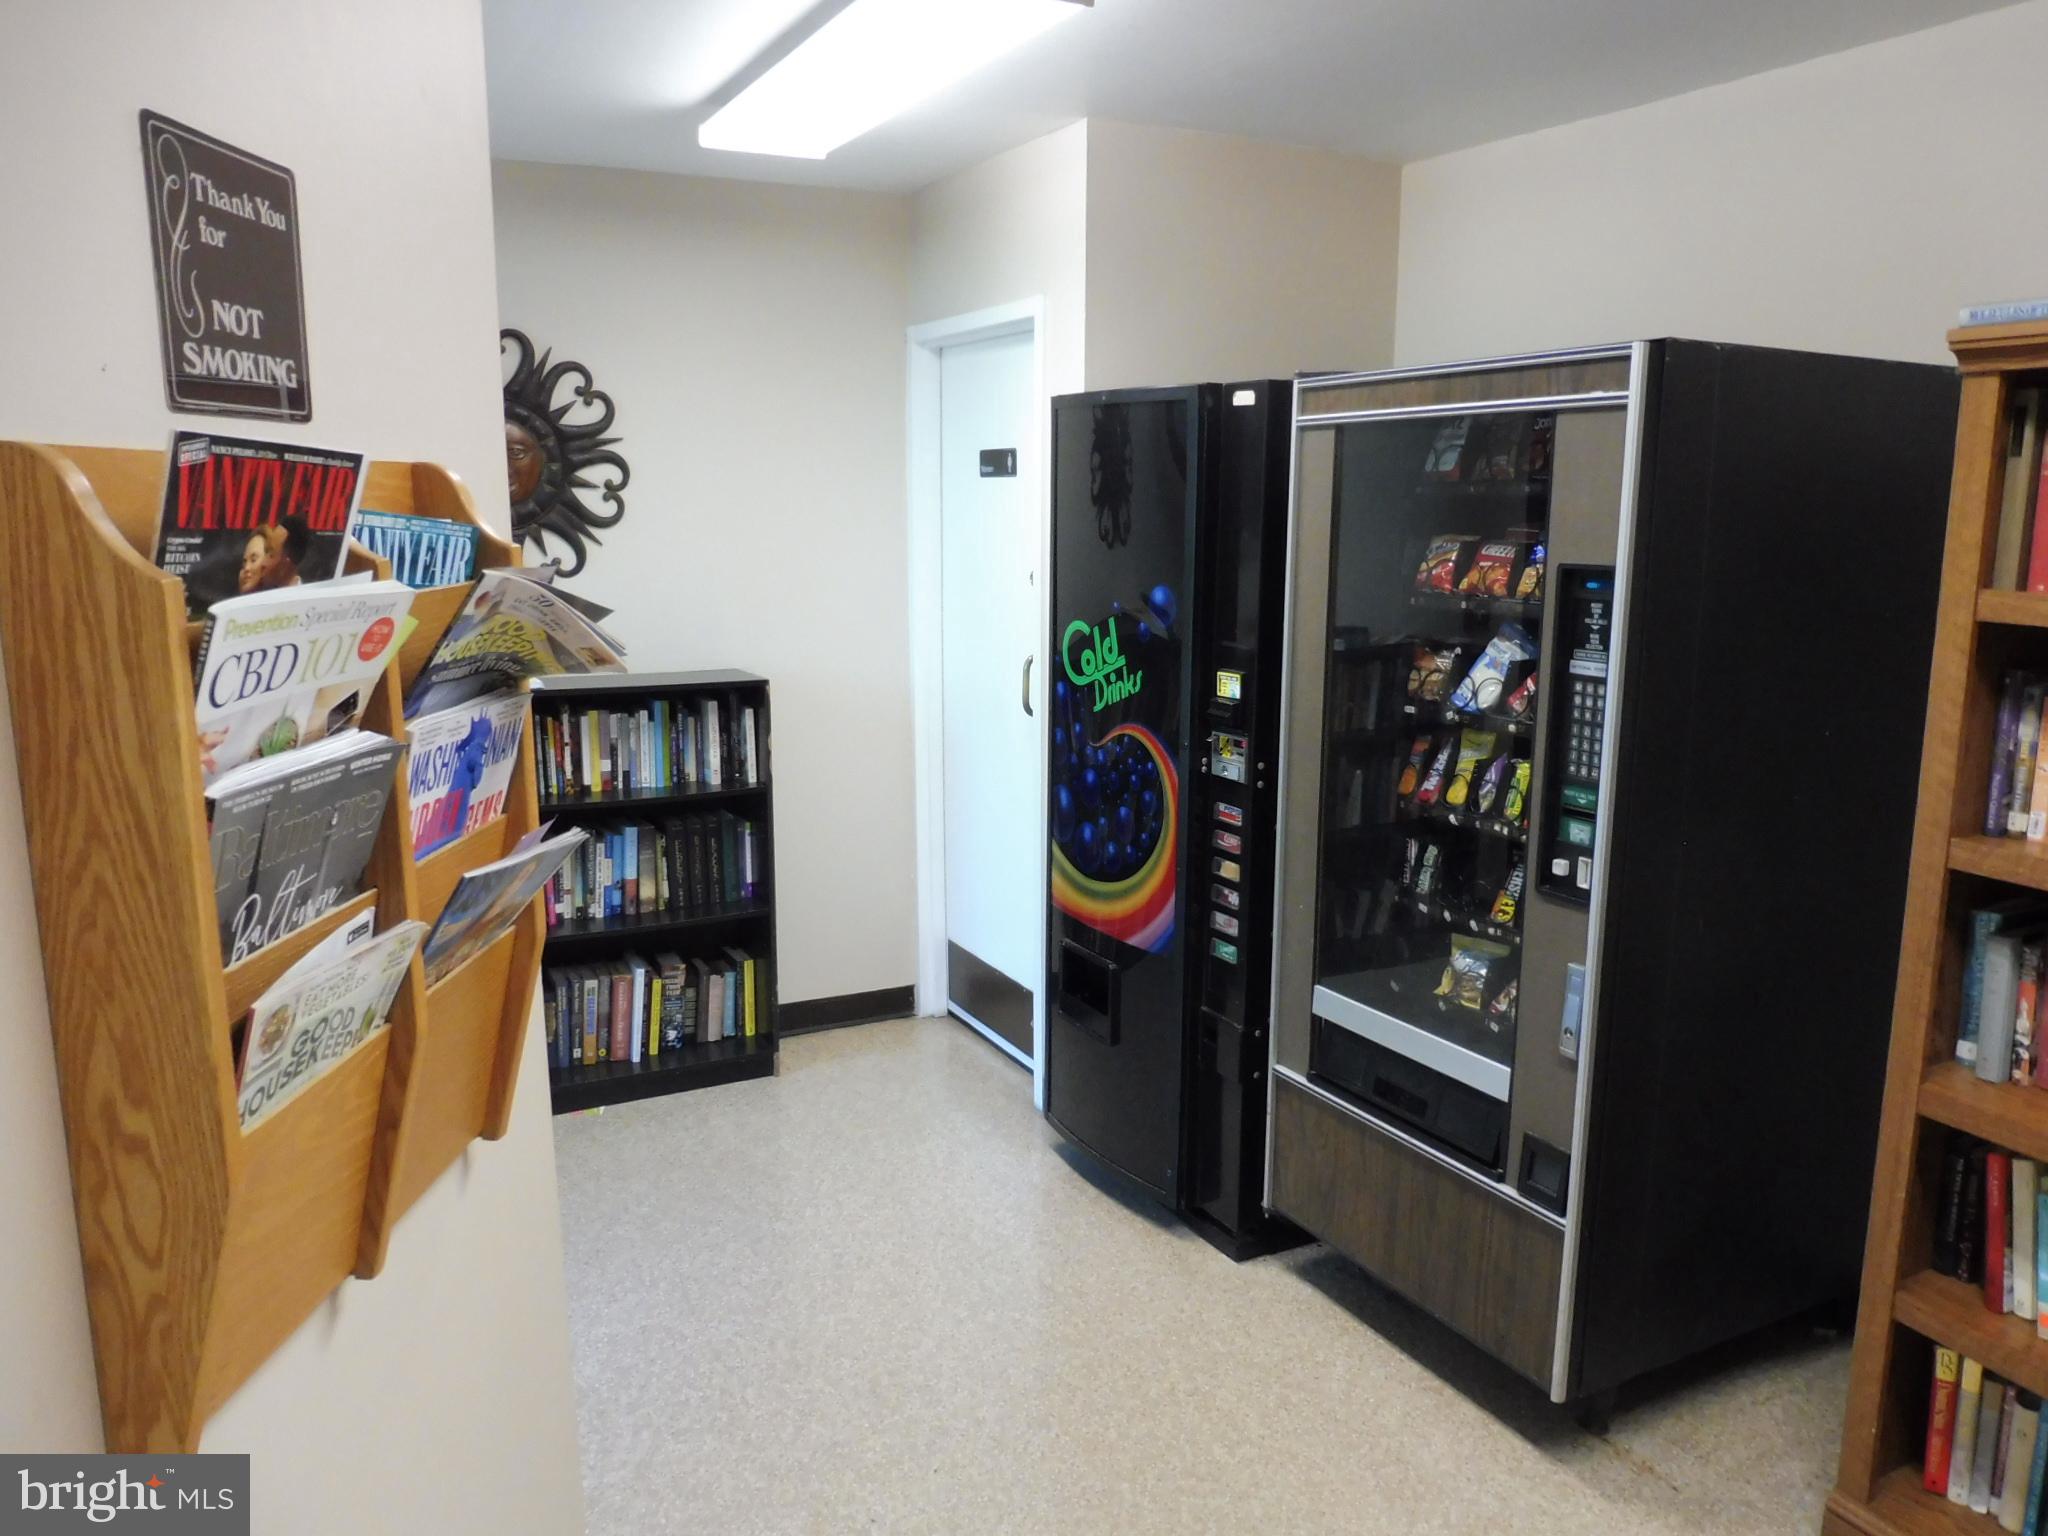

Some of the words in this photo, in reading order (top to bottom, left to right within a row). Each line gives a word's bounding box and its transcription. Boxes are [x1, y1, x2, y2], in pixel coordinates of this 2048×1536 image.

[190, 173, 255, 220] Thank
[257, 196, 287, 231] You
[198, 215, 226, 248] for
[211, 299, 264, 340] NOT
[182, 341, 299, 388] SMOKING
[177, 455, 285, 530] VANITY
[286, 462, 358, 531] FAIR
[414, 532, 472, 586] FAIR
[222, 612, 300, 642] Prevention
[1062, 616, 1126, 686] Cold
[208, 642, 299, 710] CBD
[296, 631, 359, 685] 101
[291, 1006, 355, 1058] GOOD
